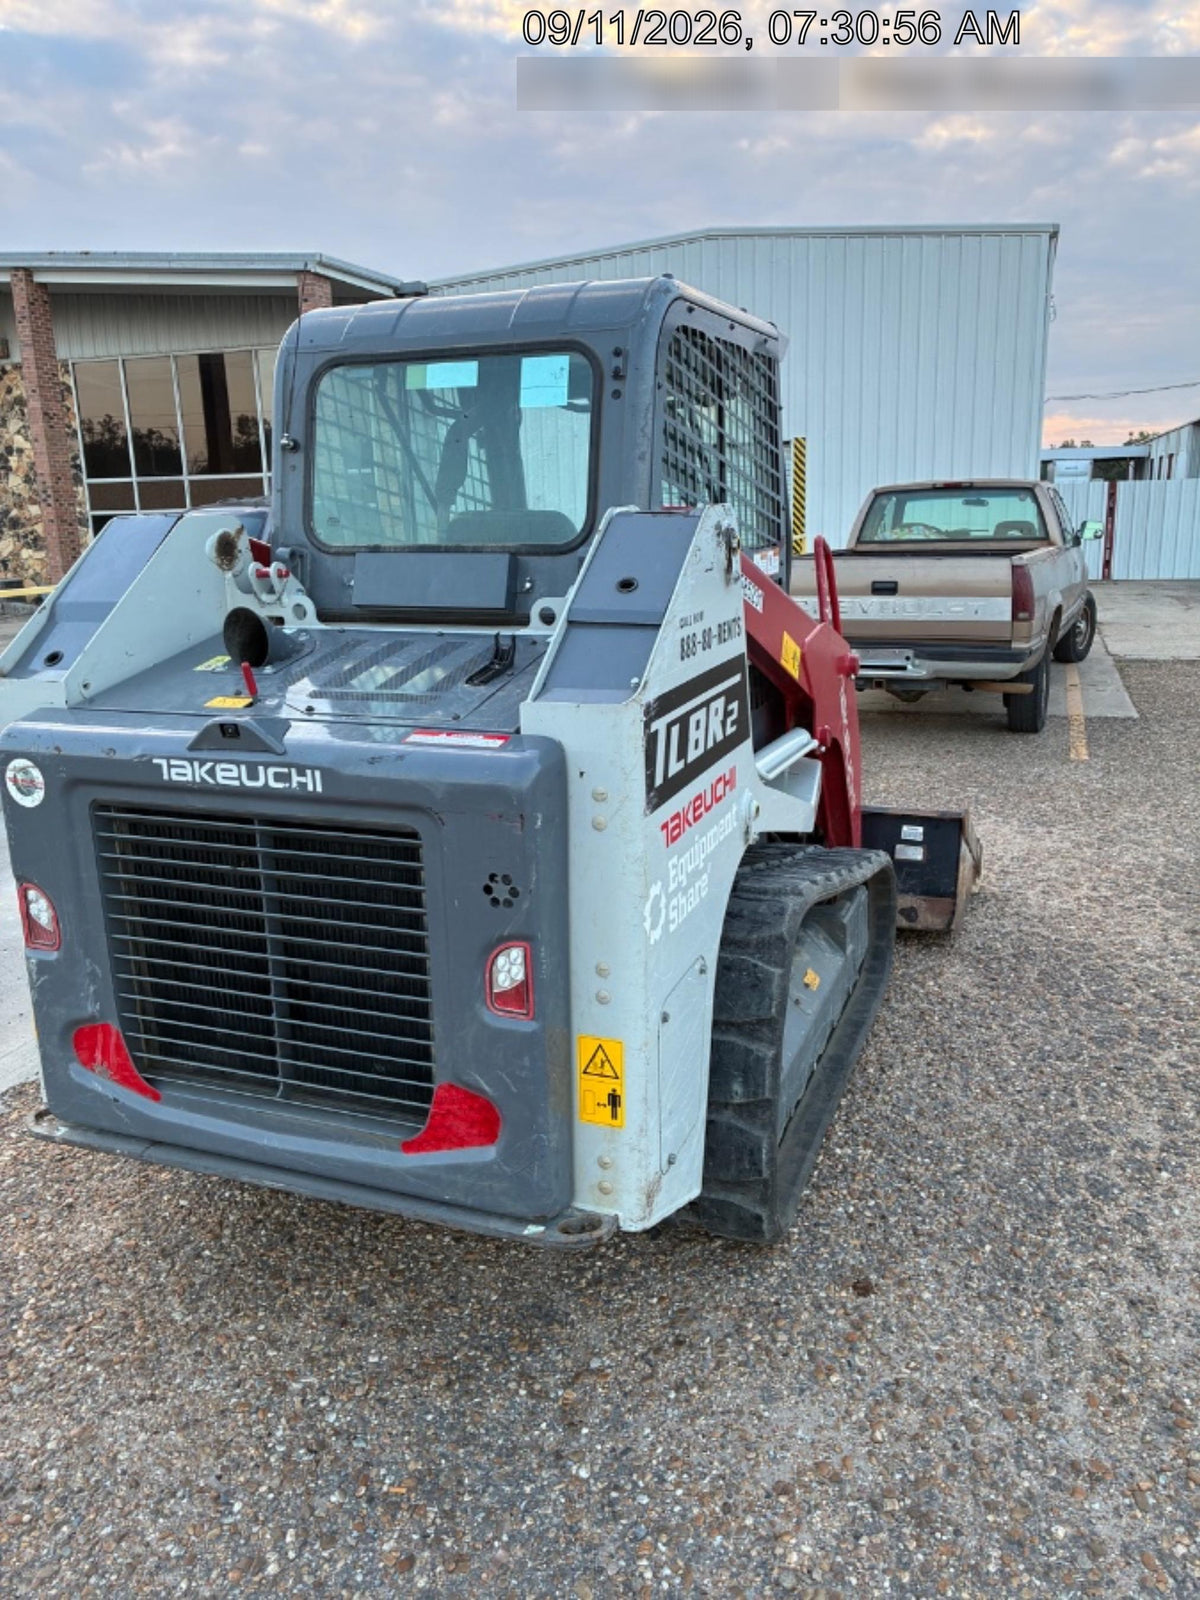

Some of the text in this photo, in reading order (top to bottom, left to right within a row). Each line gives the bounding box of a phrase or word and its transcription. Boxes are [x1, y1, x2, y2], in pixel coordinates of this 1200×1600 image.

[152, 758, 323, 793] TAKEUCHI
[660, 766, 737, 848] TAKEUCHI
[668, 803, 738, 893] Equipment
[668, 872, 709, 933] Share
